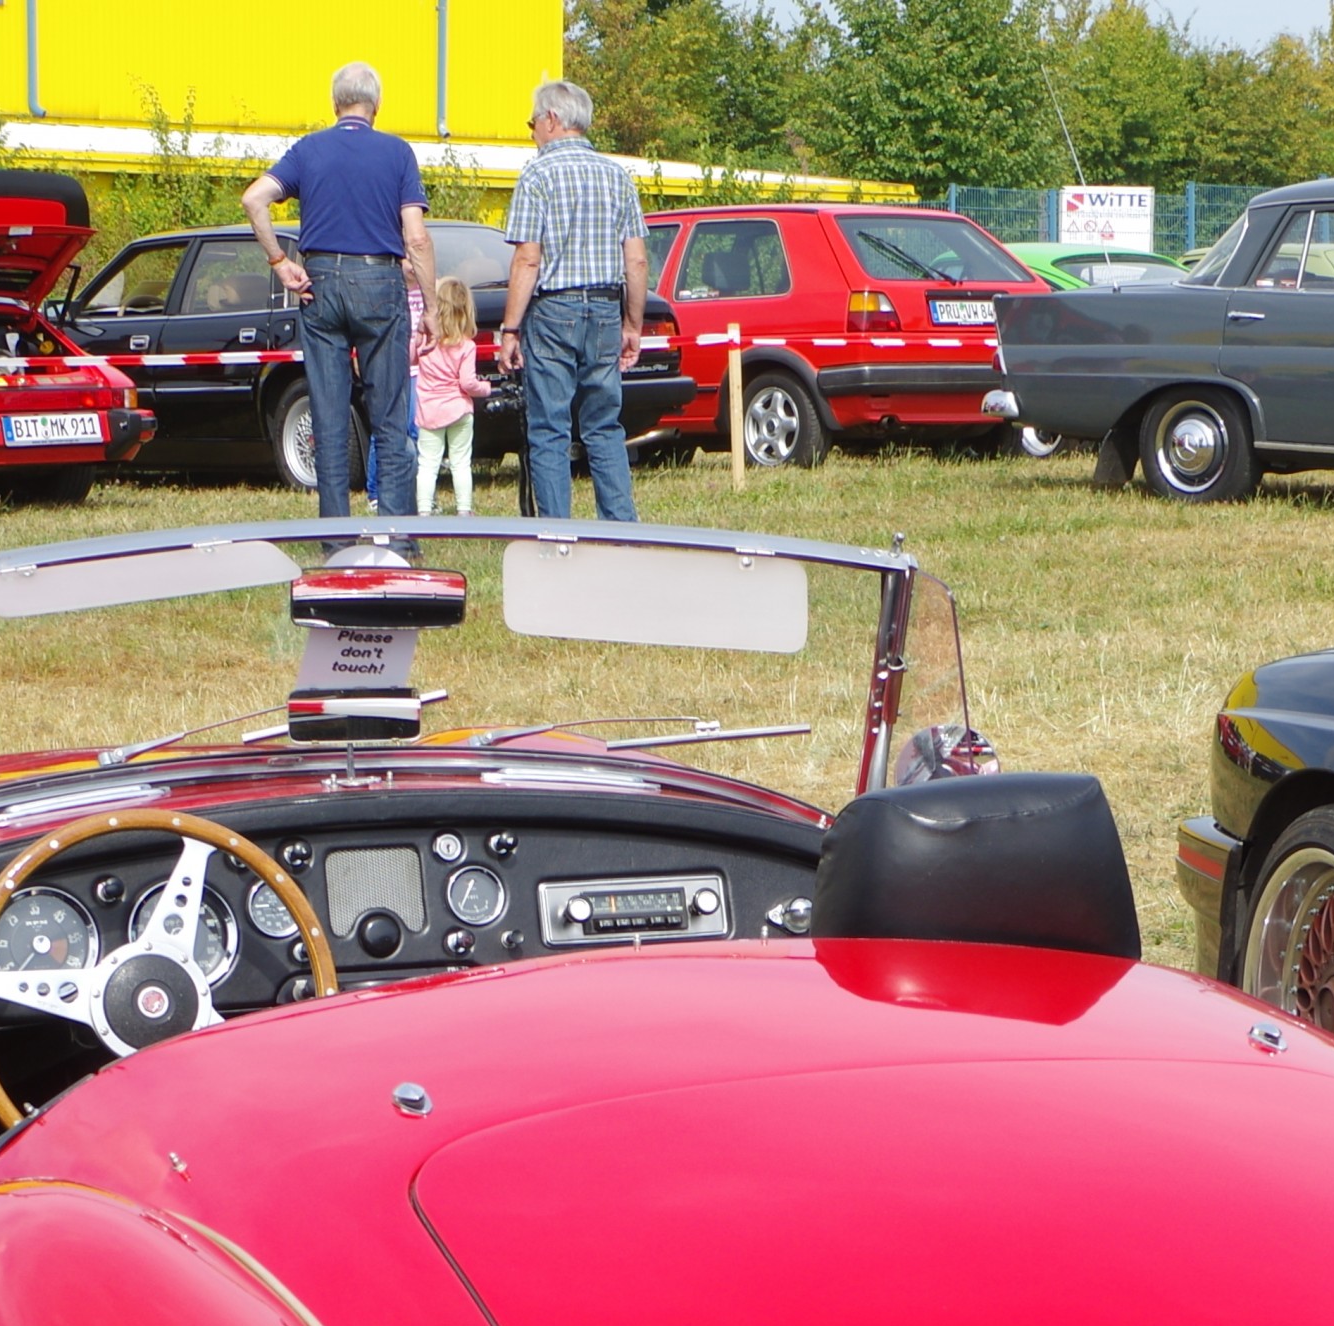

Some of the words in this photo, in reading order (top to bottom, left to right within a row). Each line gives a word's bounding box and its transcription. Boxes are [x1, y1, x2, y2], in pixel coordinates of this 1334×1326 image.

[938, 303, 960, 320] PRÜ
[13, 418, 40, 438] BIT
[50, 417, 69, 437] MK
[71, 417, 98, 435] 911
[337, 630, 394, 644] Please
[340, 646, 384, 659] don't
[332, 661, 385, 675] touch!
